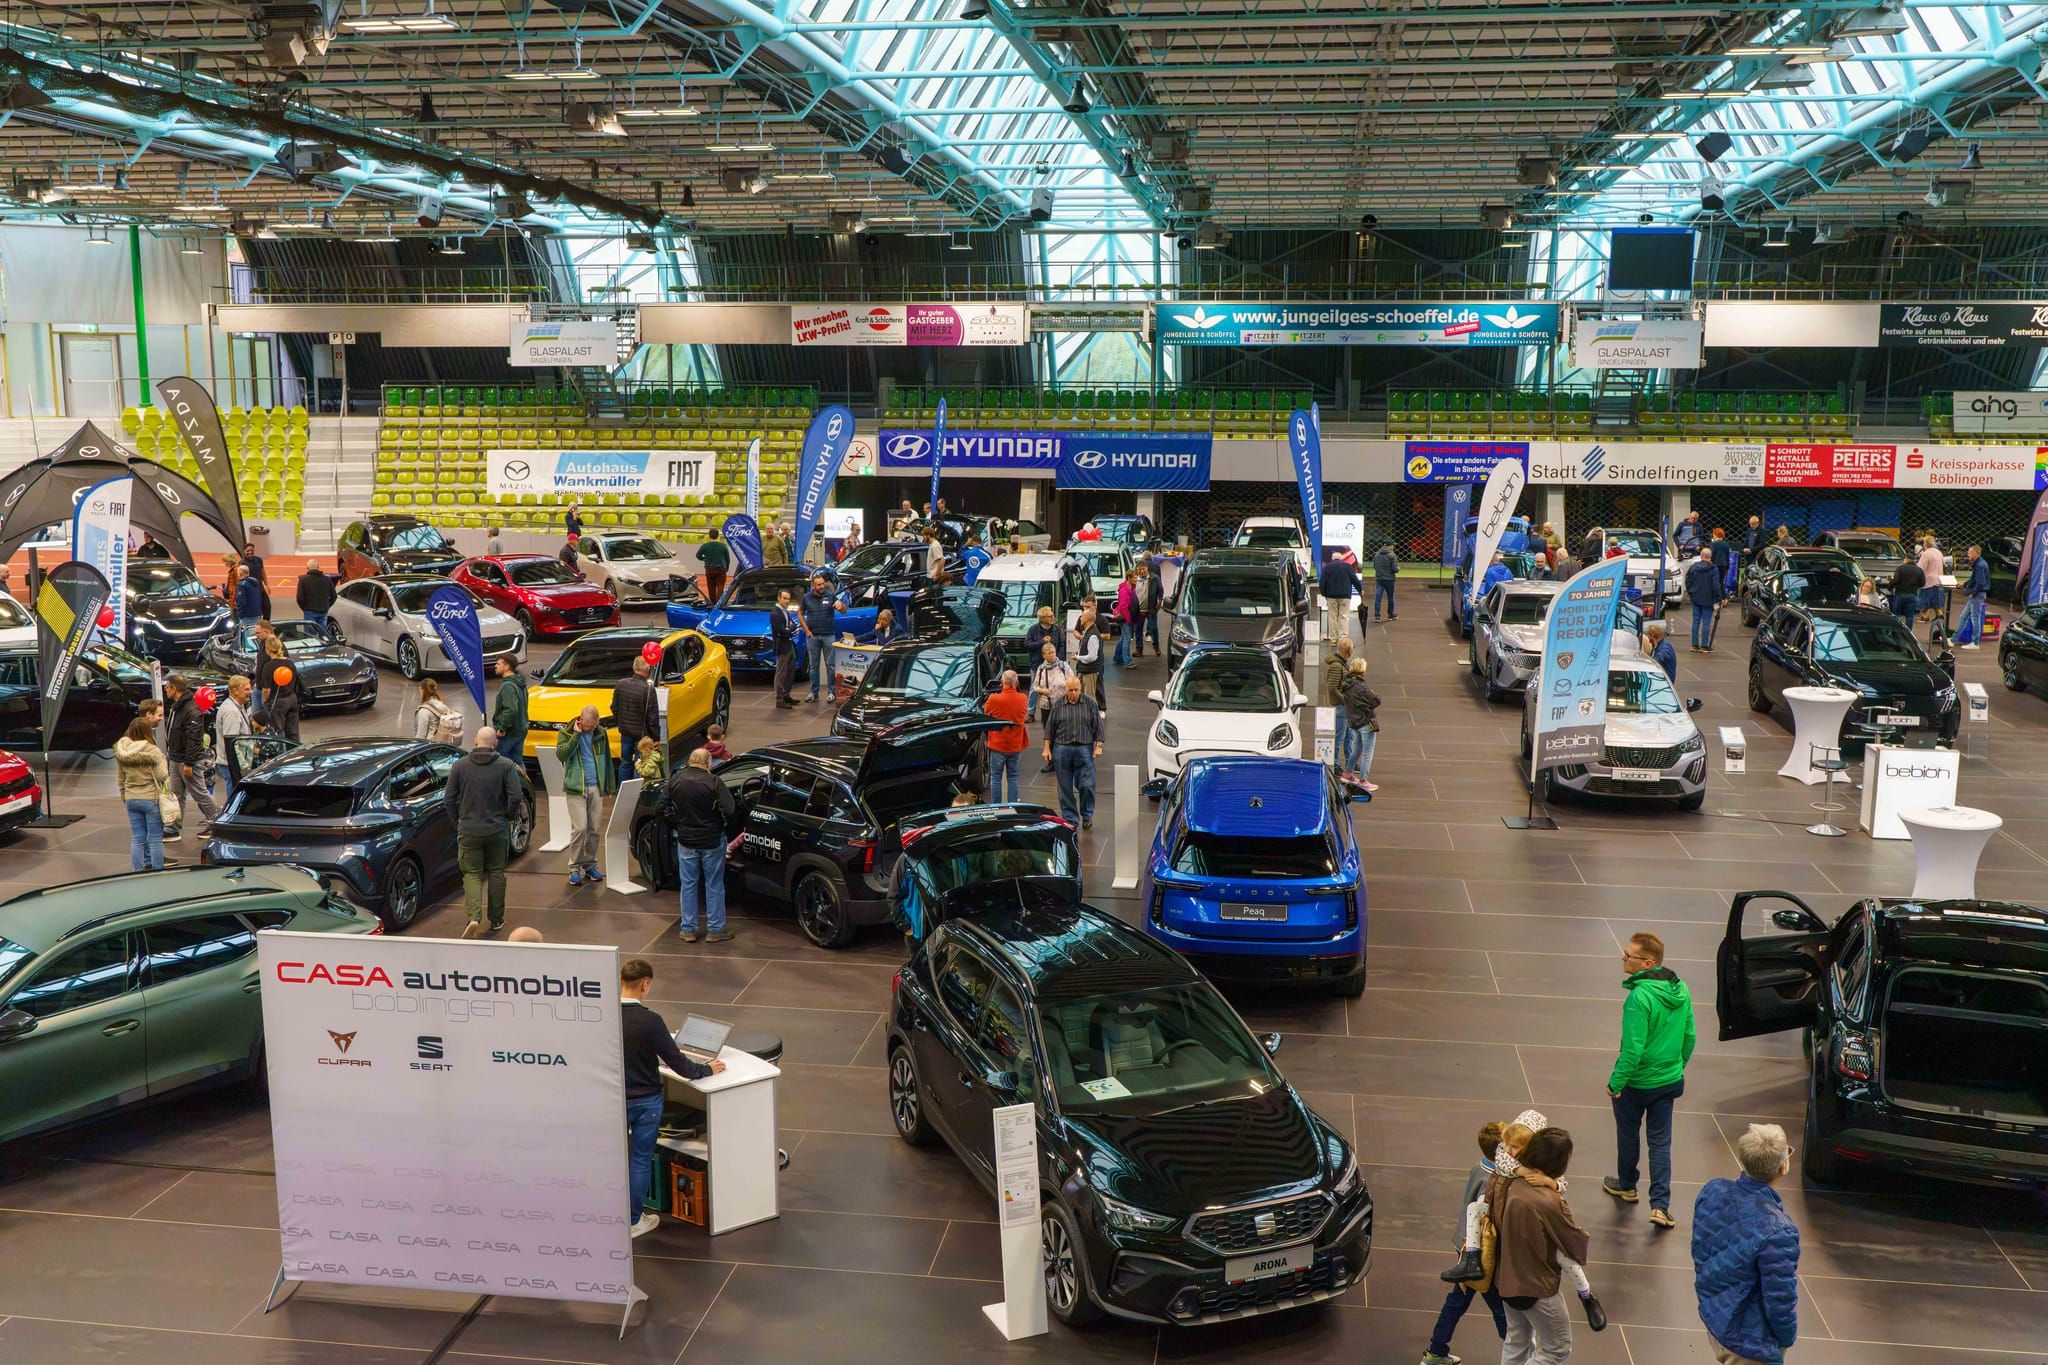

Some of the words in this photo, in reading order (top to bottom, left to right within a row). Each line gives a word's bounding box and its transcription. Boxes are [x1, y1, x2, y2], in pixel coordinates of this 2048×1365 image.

[794, 320, 811, 330] Wir
[812, 310, 848, 326] machen
[909, 317, 954, 325] GASTGEBER
[1232, 309, 1479, 326] www.jungeilges-schoeffel.de
[911, 326, 928, 335] MIT
[930, 326, 953, 335] HERZ
[2011, 328, 2043, 336] Festwirte
[1918, 337, 1972, 345] Getränkehandel
[1973, 337, 1986, 345] und
[530, 347, 593, 356] GLASPALAST
[1598, 348, 1672, 358] GLASPALAST
[942, 438, 1061, 458] HYUNDAI
[1112, 454, 1197, 468] HYUNDAI
[1724, 458, 1764, 466] ZWICKL
[1833, 449, 1892, 467] PETERS
[566, 462, 638, 473] Autohaus
[1931, 459, 2025, 472] Kreissparkasse
[668, 460, 703, 487] FIAT
[1532, 465, 1577, 479] Stadt
[1608, 465, 1719, 482] Sindelfingen
[1930, 474, 1994, 487] Böblingen
[554, 476, 643, 487] Wankmüller
[1301, 450, 1320, 532] HYUNDAI
[110, 502, 127, 516] FIAT
[1482, 472, 1520, 538] bebion
[726, 524, 754, 538] Ford
[1590, 579, 1613, 588] ÜBER
[1584, 590, 1612, 599] JAHRE
[432, 600, 469, 620] Ford
[1558, 614, 1584, 627] FÜR
[438, 623, 464, 661] Autohaus
[1546, 734, 1599, 750] bebion
[1544, 752, 1599, 761] www.auto-bebion.de
[1621, 772, 1652, 780] bebion
[1886, 764, 1951, 779] bebion
[1244, 907, 1265, 917] Peaq
[277, 962, 394, 988] CASA
[403, 970, 601, 999] automobile
[352, 989, 515, 1022] böblingen
[531, 998, 603, 1023] hub
[318, 1057, 372, 1068] CUPRA
[410, 1062, 454, 1072] SEAT
[292, 1194, 344, 1208] CASA
[360, 1199, 413, 1213] CASA
[431, 1203, 484, 1217] CASA
[501, 1209, 554, 1222] CASA
[571, 1213, 626, 1226] CASA
[329, 1230, 381, 1243] CASA
[398, 1235, 451, 1249] CASA
[468, 1240, 521, 1254] CASA
[538, 1245, 592, 1258] CASA
[1253, 1258, 1288, 1273] ARONA
[297, 1262, 349, 1274] CASA
[366, 1267, 418, 1280] CASA
[435, 1271, 488, 1285] CASA
[504, 1277, 559, 1290] CASA
[576, 1281, 630, 1295] CASA
